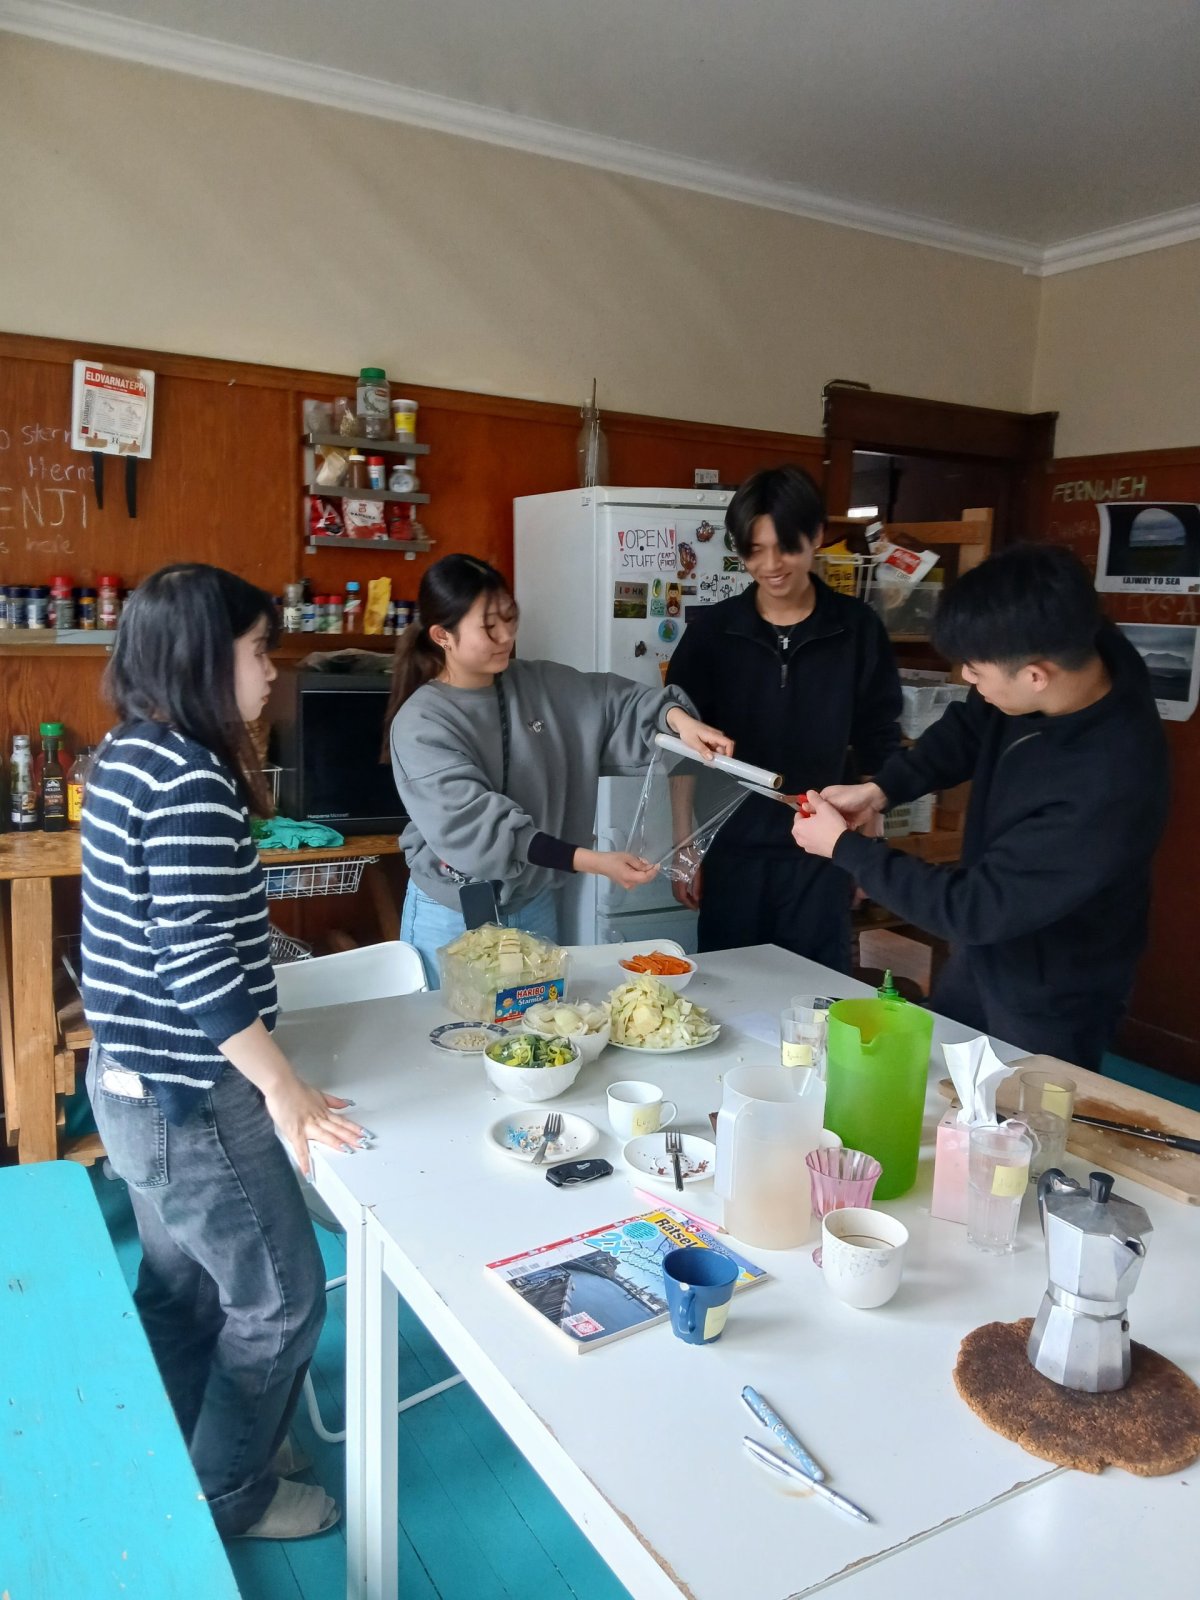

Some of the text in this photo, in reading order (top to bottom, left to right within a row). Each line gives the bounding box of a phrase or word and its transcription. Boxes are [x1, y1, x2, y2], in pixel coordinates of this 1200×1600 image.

[85, 370, 146, 393] ELDVARNATEPPI
[1052, 475, 1147, 502] FERNWEH
[622, 554, 656, 568] STUFF
[1153, 577, 1163, 585] TO
[1165, 578, 1181, 586] SEA
[516, 986, 546, 999] HARIBO
[654, 1217, 701, 1248] Rätsel
